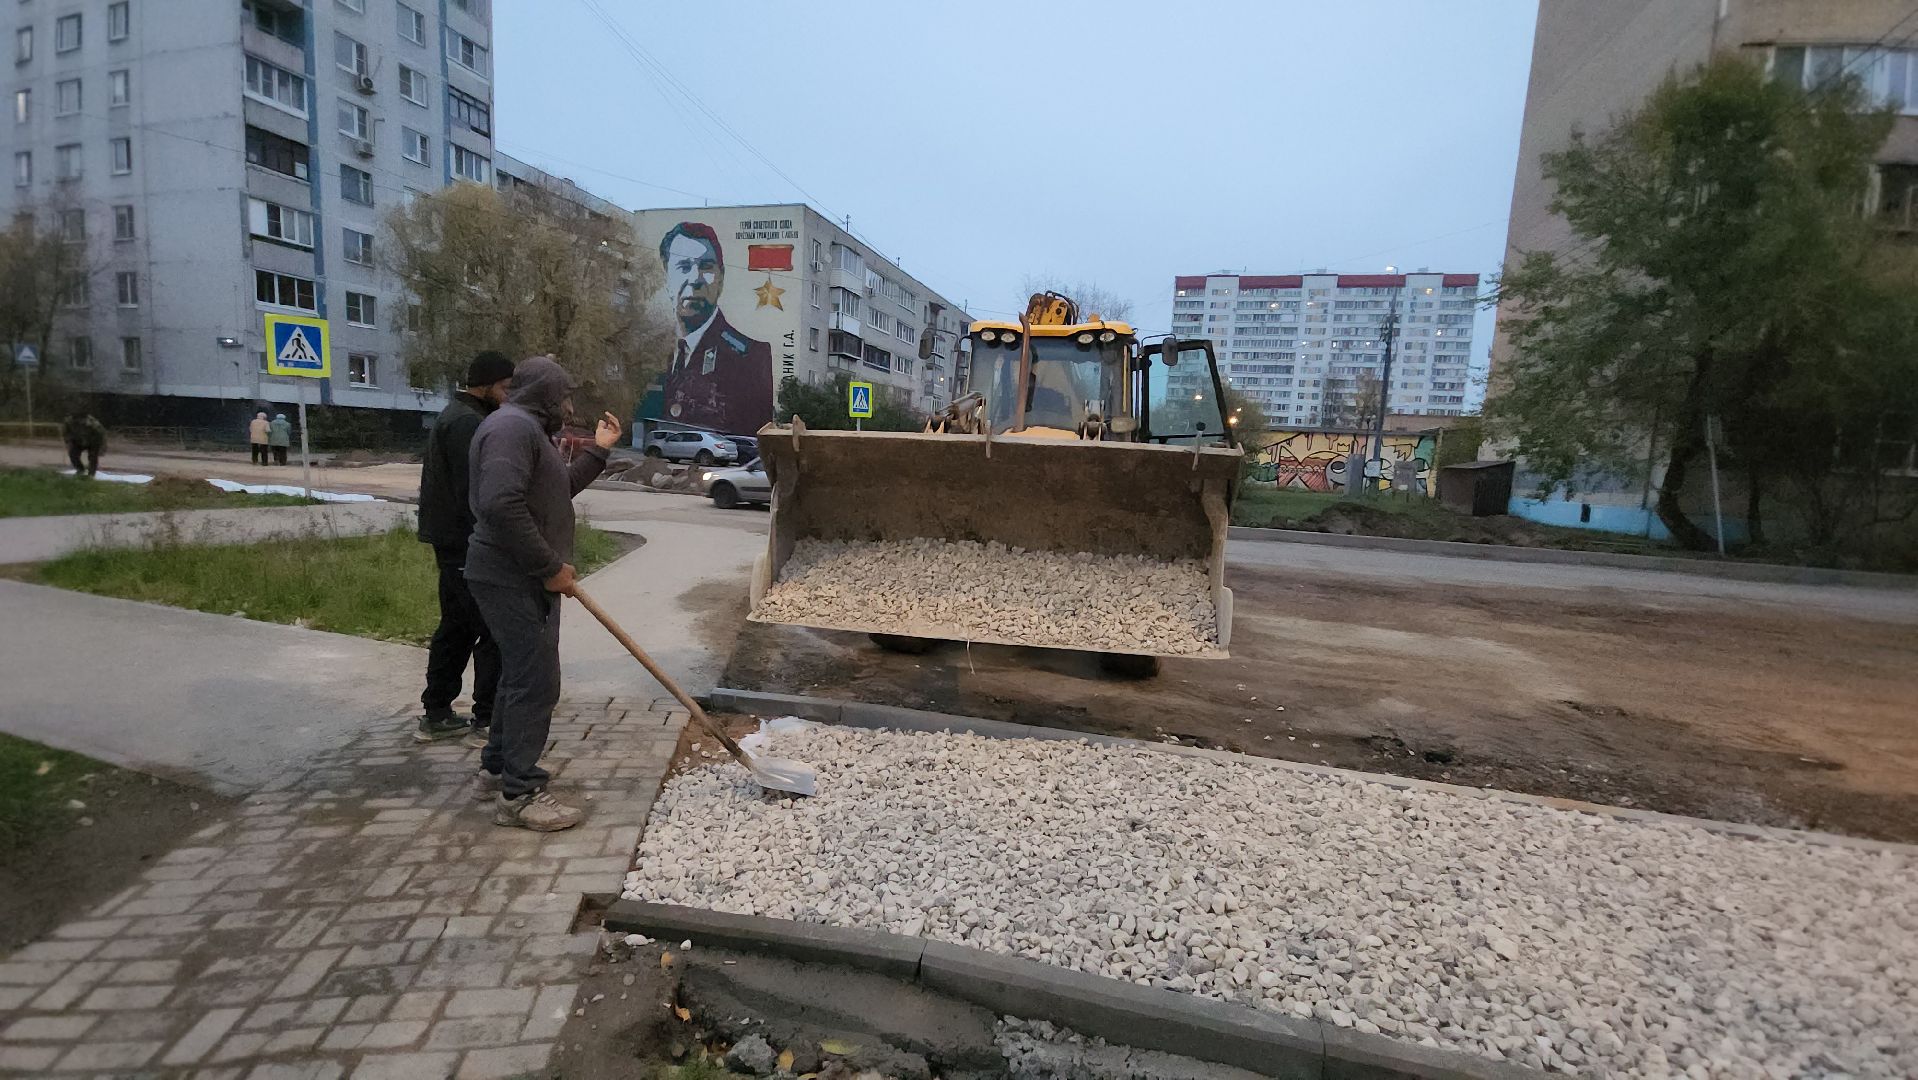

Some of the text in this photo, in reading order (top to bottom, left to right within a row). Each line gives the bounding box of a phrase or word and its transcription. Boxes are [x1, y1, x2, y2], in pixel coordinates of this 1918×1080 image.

[740, 219, 793, 229] ГЕРОЙ СОВЕТСКОГО СОЮЗА
[757, 231, 780, 240] ГРАЖДАНИН
[783, 329, 795, 381] ДНИК Г.А.
